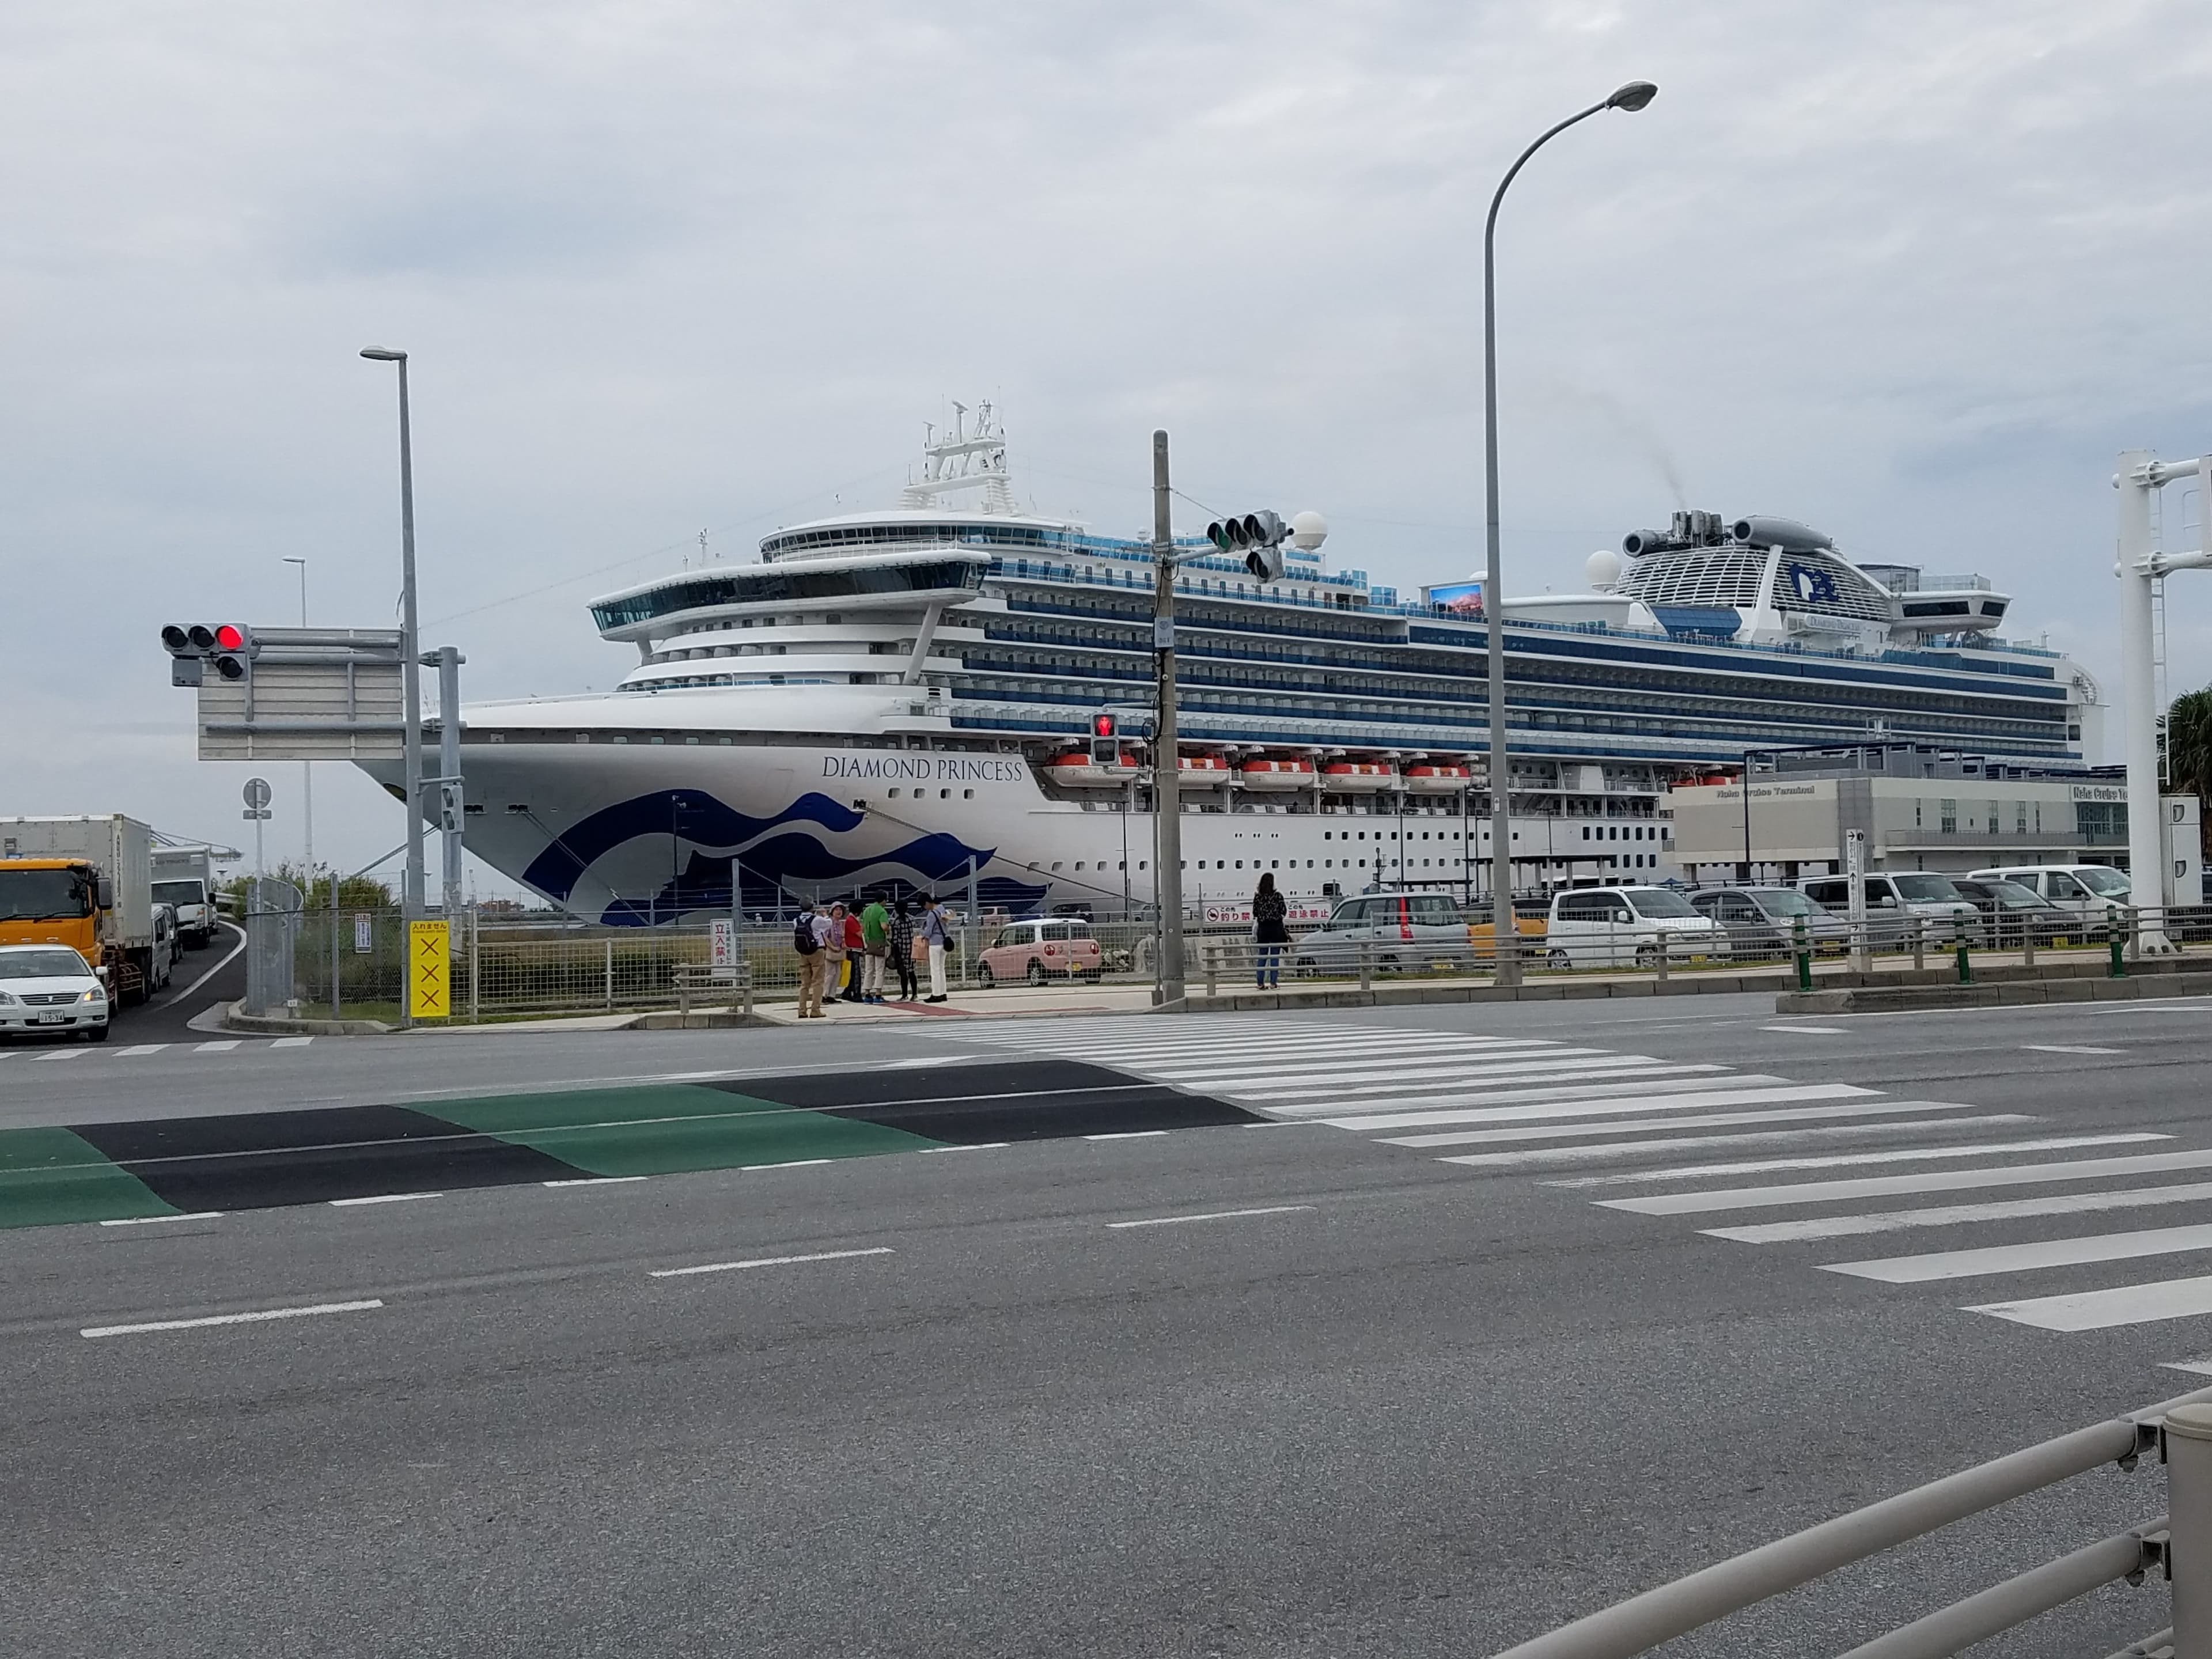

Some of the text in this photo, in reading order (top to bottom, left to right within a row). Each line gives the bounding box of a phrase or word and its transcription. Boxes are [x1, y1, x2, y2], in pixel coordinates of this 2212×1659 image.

[822, 756, 1022, 781] DIAMOND PRINCESS
[2074, 786, 2093, 799] Naha
[1221, 912, 1252, 921] 釣り禁
[715, 923, 726, 964] 立入禁止
